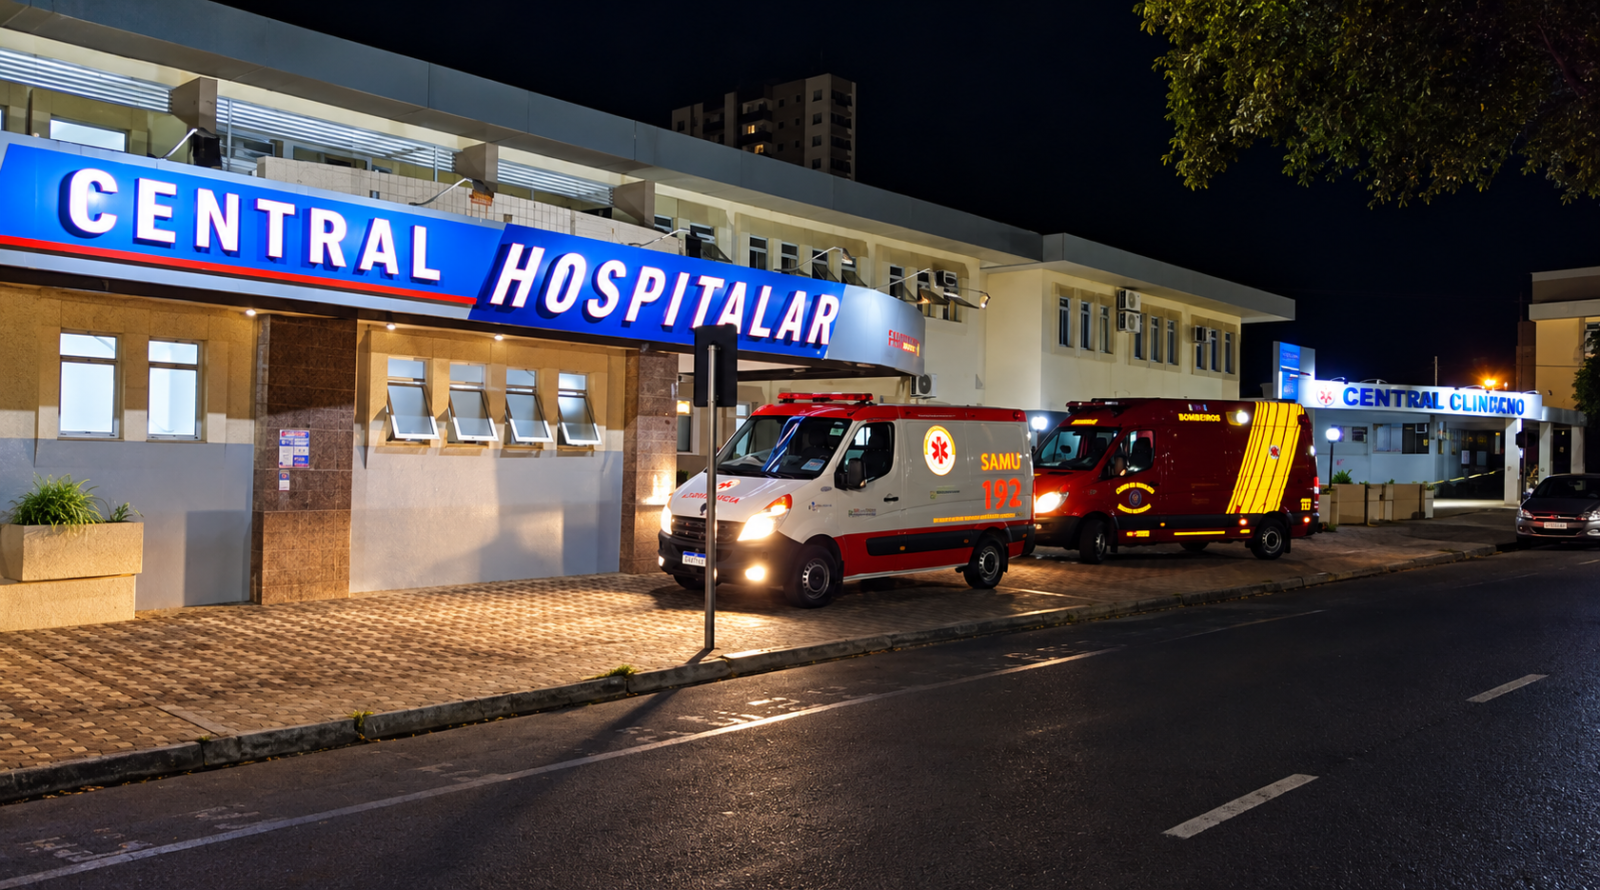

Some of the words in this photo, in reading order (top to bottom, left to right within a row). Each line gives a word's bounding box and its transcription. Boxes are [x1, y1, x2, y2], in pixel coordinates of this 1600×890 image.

[67, 167, 441, 281] CENTRAL
[490, 242, 840, 345] HOSPITALAR
[1343, 387, 1445, 409] CENTRAL
[980, 452, 1021, 471] SAMU
[982, 478, 1022, 510] 192
